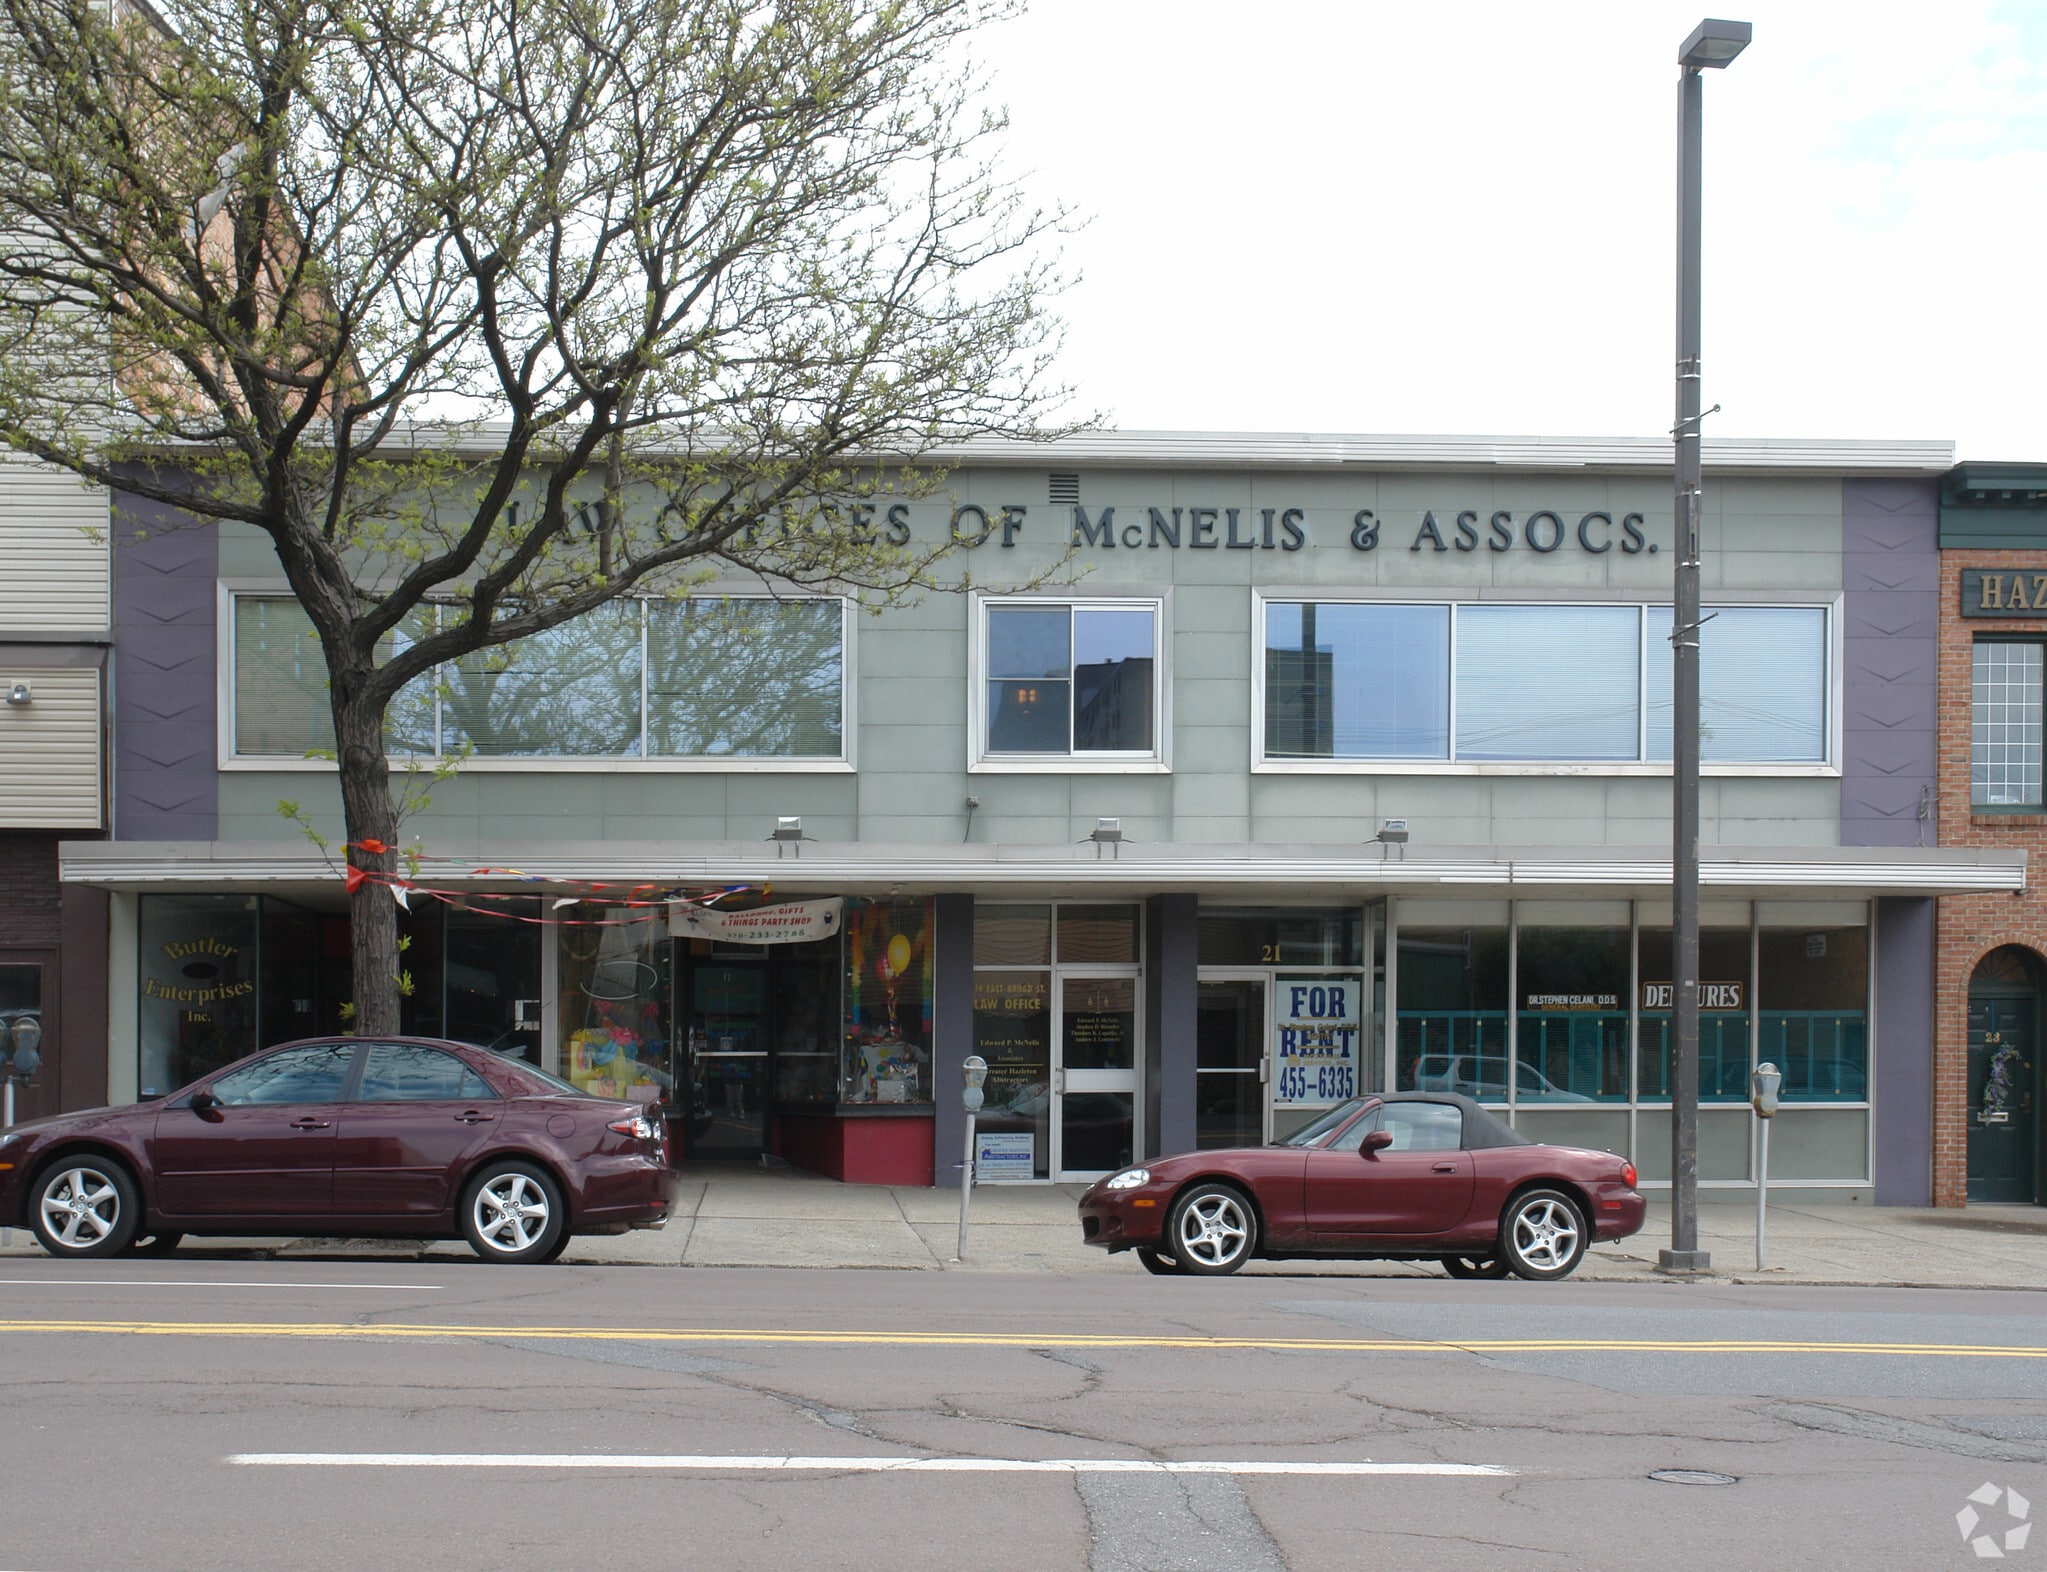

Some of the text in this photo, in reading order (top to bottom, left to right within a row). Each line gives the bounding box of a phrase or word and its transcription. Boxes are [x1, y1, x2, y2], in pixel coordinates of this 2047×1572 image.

[505, 501, 618, 543] LW
[951, 503, 1027, 548] OF
[1072, 506, 1306, 551] McNELIS
[1350, 509, 1381, 551] &
[1410, 510, 1659, 553] ASSOCS.
[1980, 575, 2047, 609] HAZ
[728, 918, 758, 926] THINGS
[761, 918, 788, 926] PARTY
[789, 917, 812, 926] SHOP
[778, 907, 805, 915] GIFTS
[161, 936, 238, 961] Butler
[1261, 944, 1281, 962] 21
[144, 976, 253, 1007] Enterprises
[986, 984, 1003, 993] EAST
[1007, 984, 1033, 993] BROAD
[1645, 985, 1740, 1007] DEURES
[974, 998, 1041, 1010] LAW OFFICE
[1290, 986, 1346, 1018] FOR
[188, 1010, 212, 1022] Inc.
[1280, 1026, 1355, 1058] RENT
[1985, 1031, 2000, 1043] 23
[1280, 1066, 1353, 1098] 455-6335
